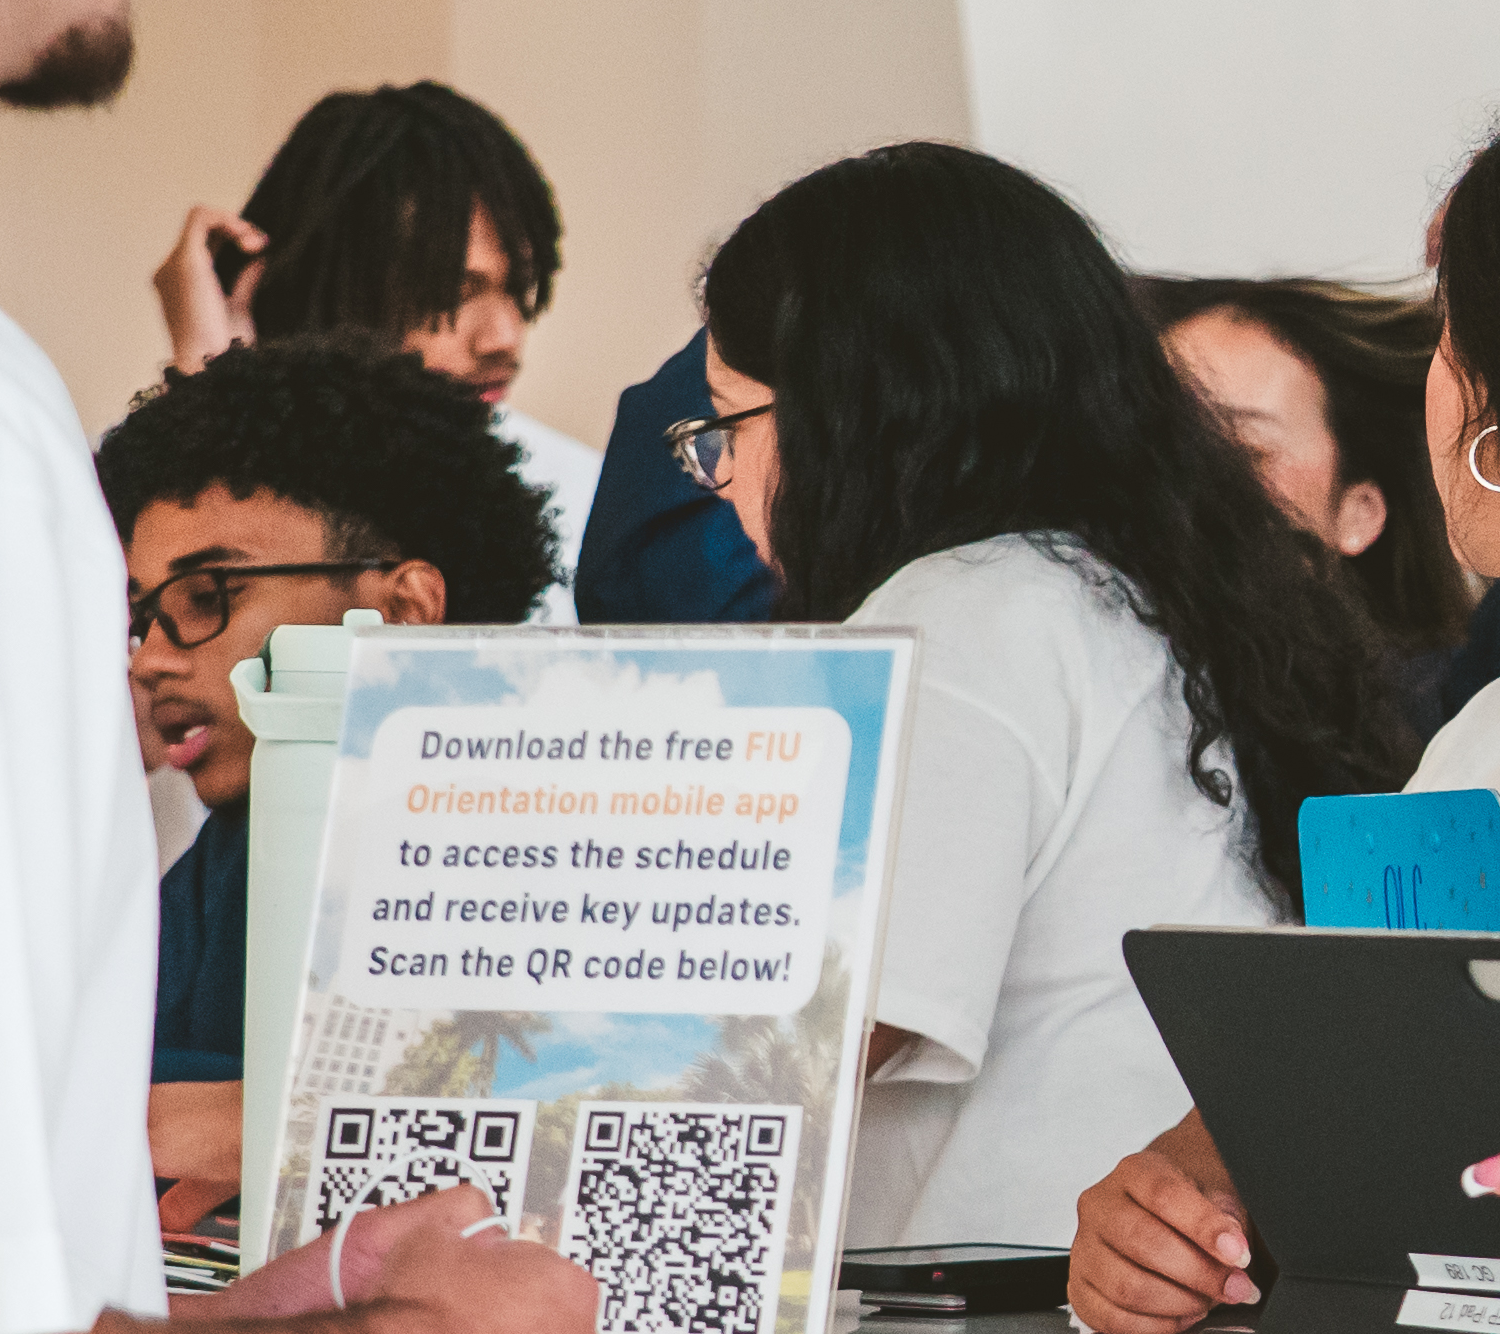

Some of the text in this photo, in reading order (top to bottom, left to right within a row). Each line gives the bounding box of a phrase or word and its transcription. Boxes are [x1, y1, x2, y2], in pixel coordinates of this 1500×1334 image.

[421, 729, 803, 763] Download the free FIU
[406, 783, 801, 824] Orientation mobile app
[398, 838, 792, 871] to access the schedule
[372, 891, 801, 932] and receive key updates.
[368, 945, 792, 985] Scan the QR code below!
[1440, 1302, 1454, 1320] 12
[1459, 1303, 1488, 1324] iPad
